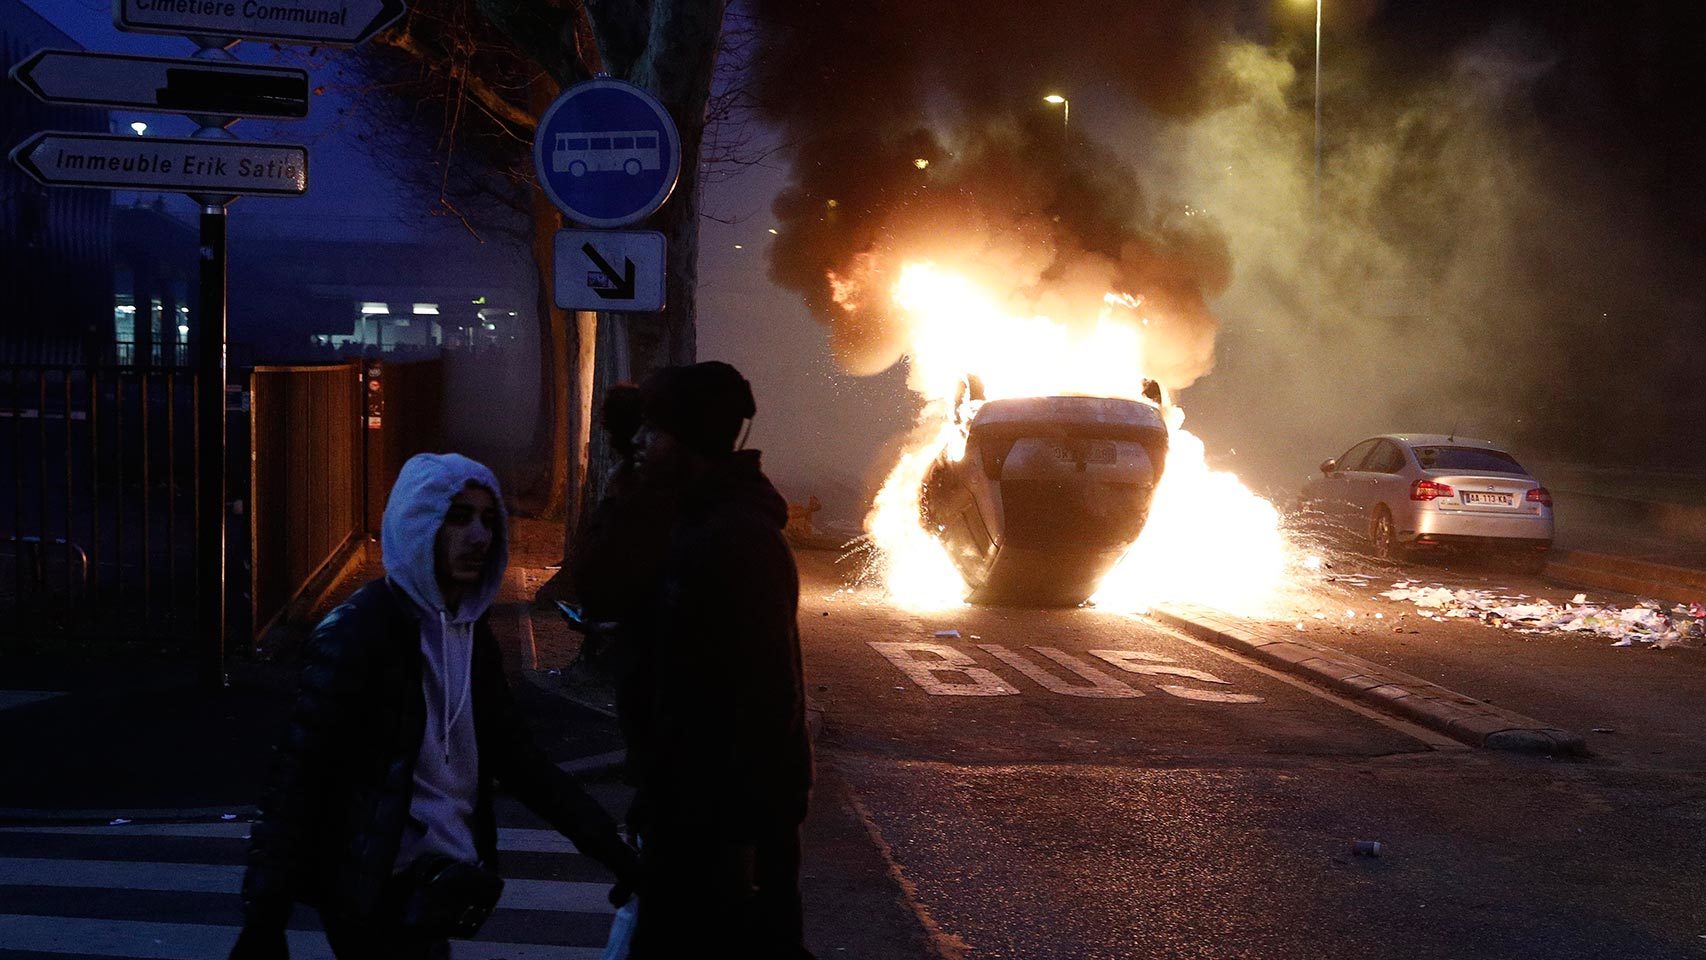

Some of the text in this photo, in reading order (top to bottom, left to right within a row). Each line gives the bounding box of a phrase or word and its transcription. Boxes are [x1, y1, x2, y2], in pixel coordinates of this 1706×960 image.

[243, 1, 347, 25] Communal
[56, 150, 298, 179] Immeuble Erik Satie
[866, 641, 1265, 704] BUS
